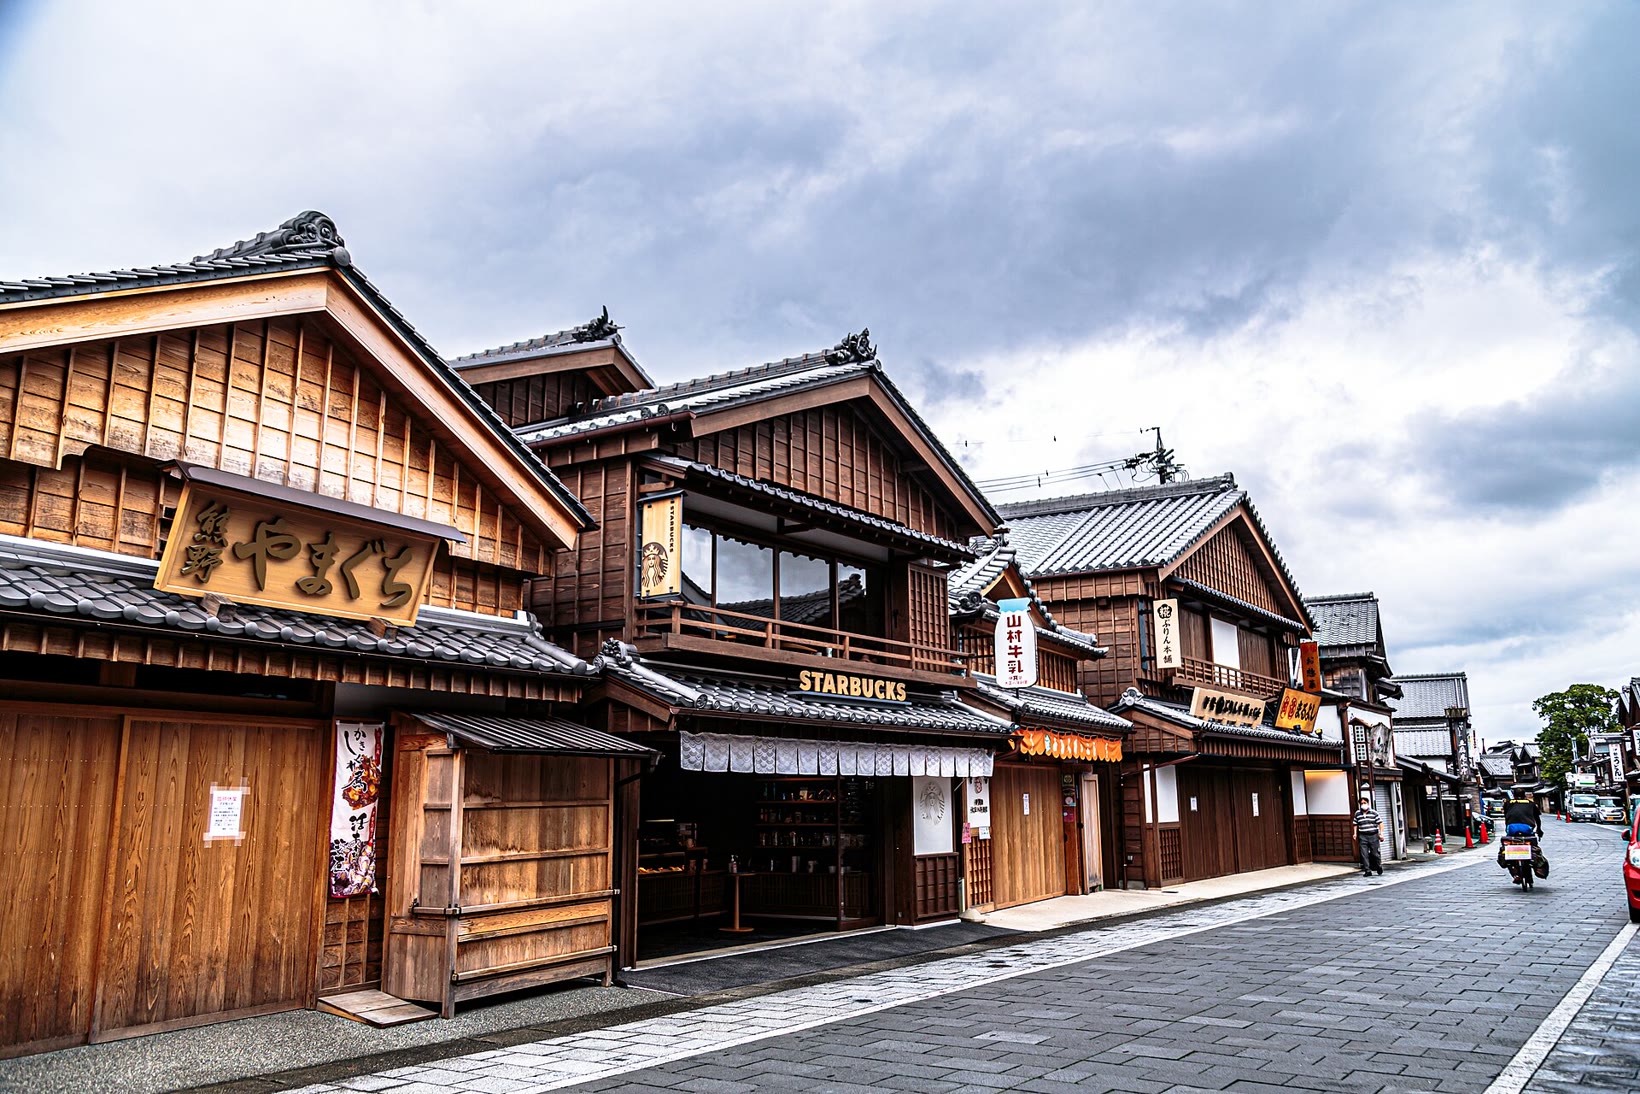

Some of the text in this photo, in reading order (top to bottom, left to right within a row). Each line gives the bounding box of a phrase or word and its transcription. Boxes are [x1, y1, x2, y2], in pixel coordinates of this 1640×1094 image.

[181, 501, 230, 584] 熊野
[233, 516, 414, 609] やまぐち
[1006, 614, 1024, 674] 山村牛乳
[799, 670, 907, 702] STARBUCKS
[1295, 699, 1316, 722] まるよし
